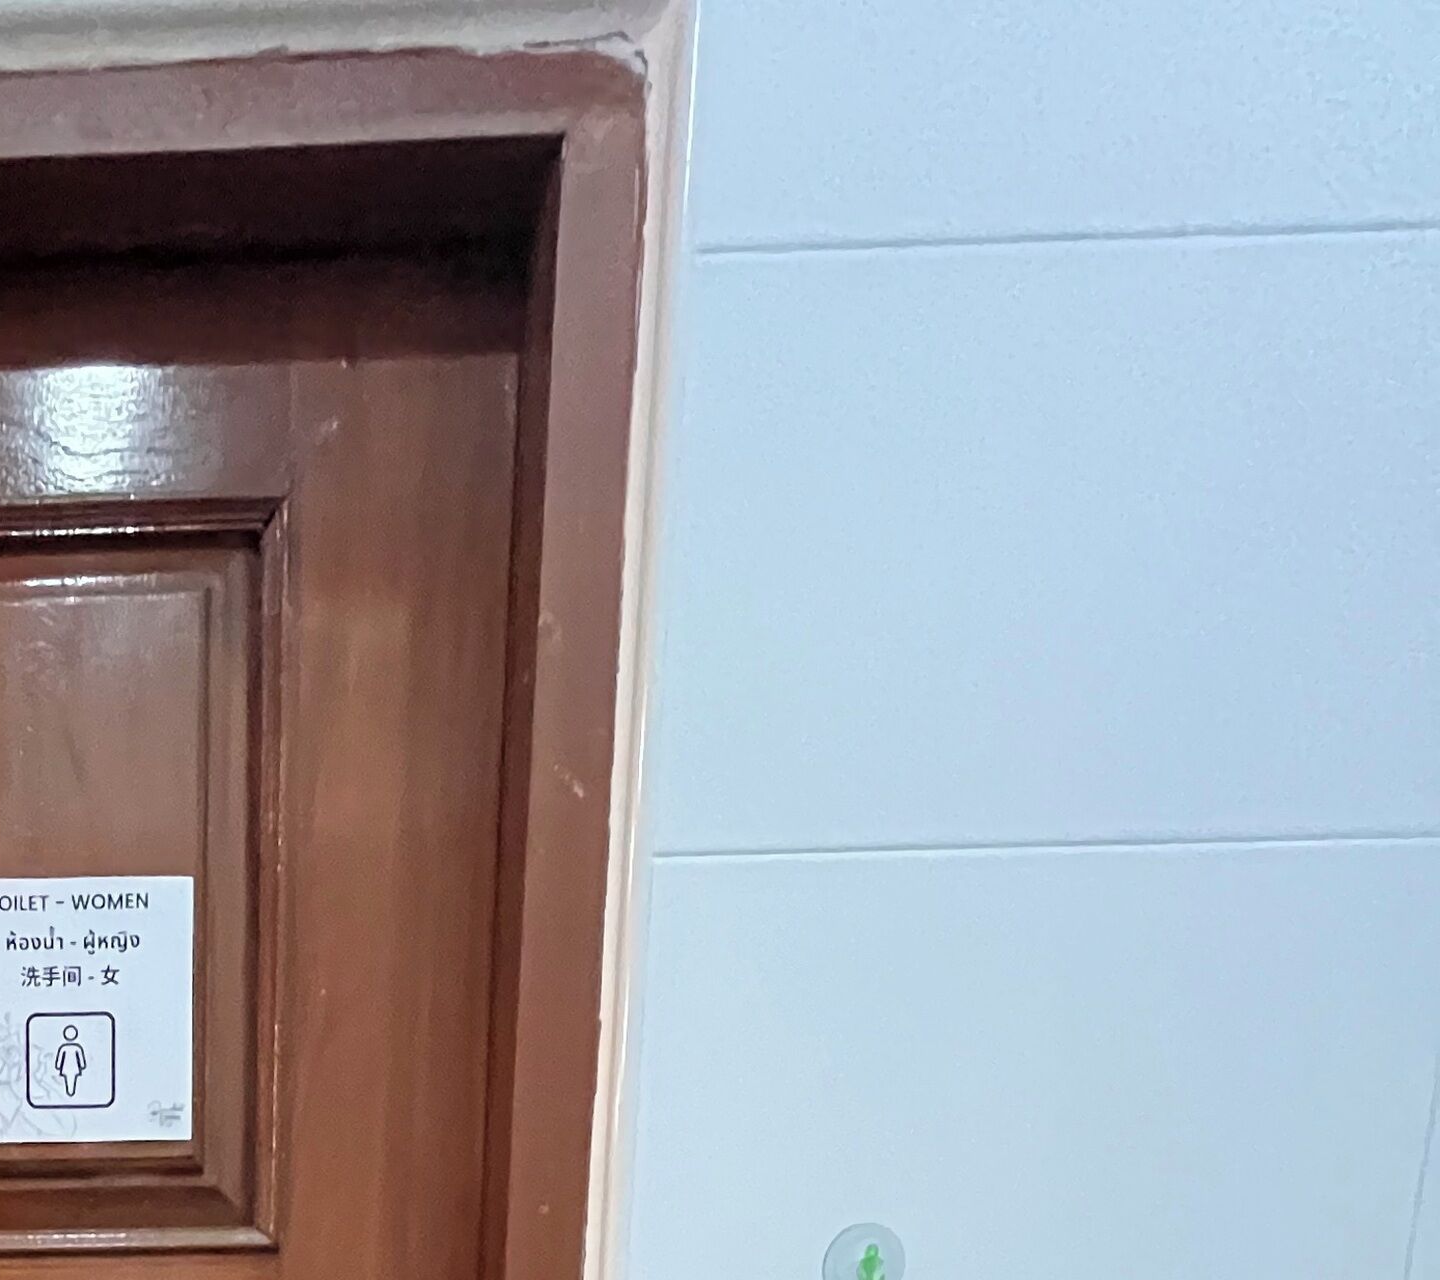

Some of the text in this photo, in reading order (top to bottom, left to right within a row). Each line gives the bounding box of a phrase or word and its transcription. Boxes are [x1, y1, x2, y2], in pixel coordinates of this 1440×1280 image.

[71, 892, 150, 911] WOMEN
[6, 926, 64, 951] ห้องน้ำ
[83, 929, 141, 956] ผู้หญิง
[20, 965, 82, 988] 洗手间
[100, 964, 120, 986] 女
